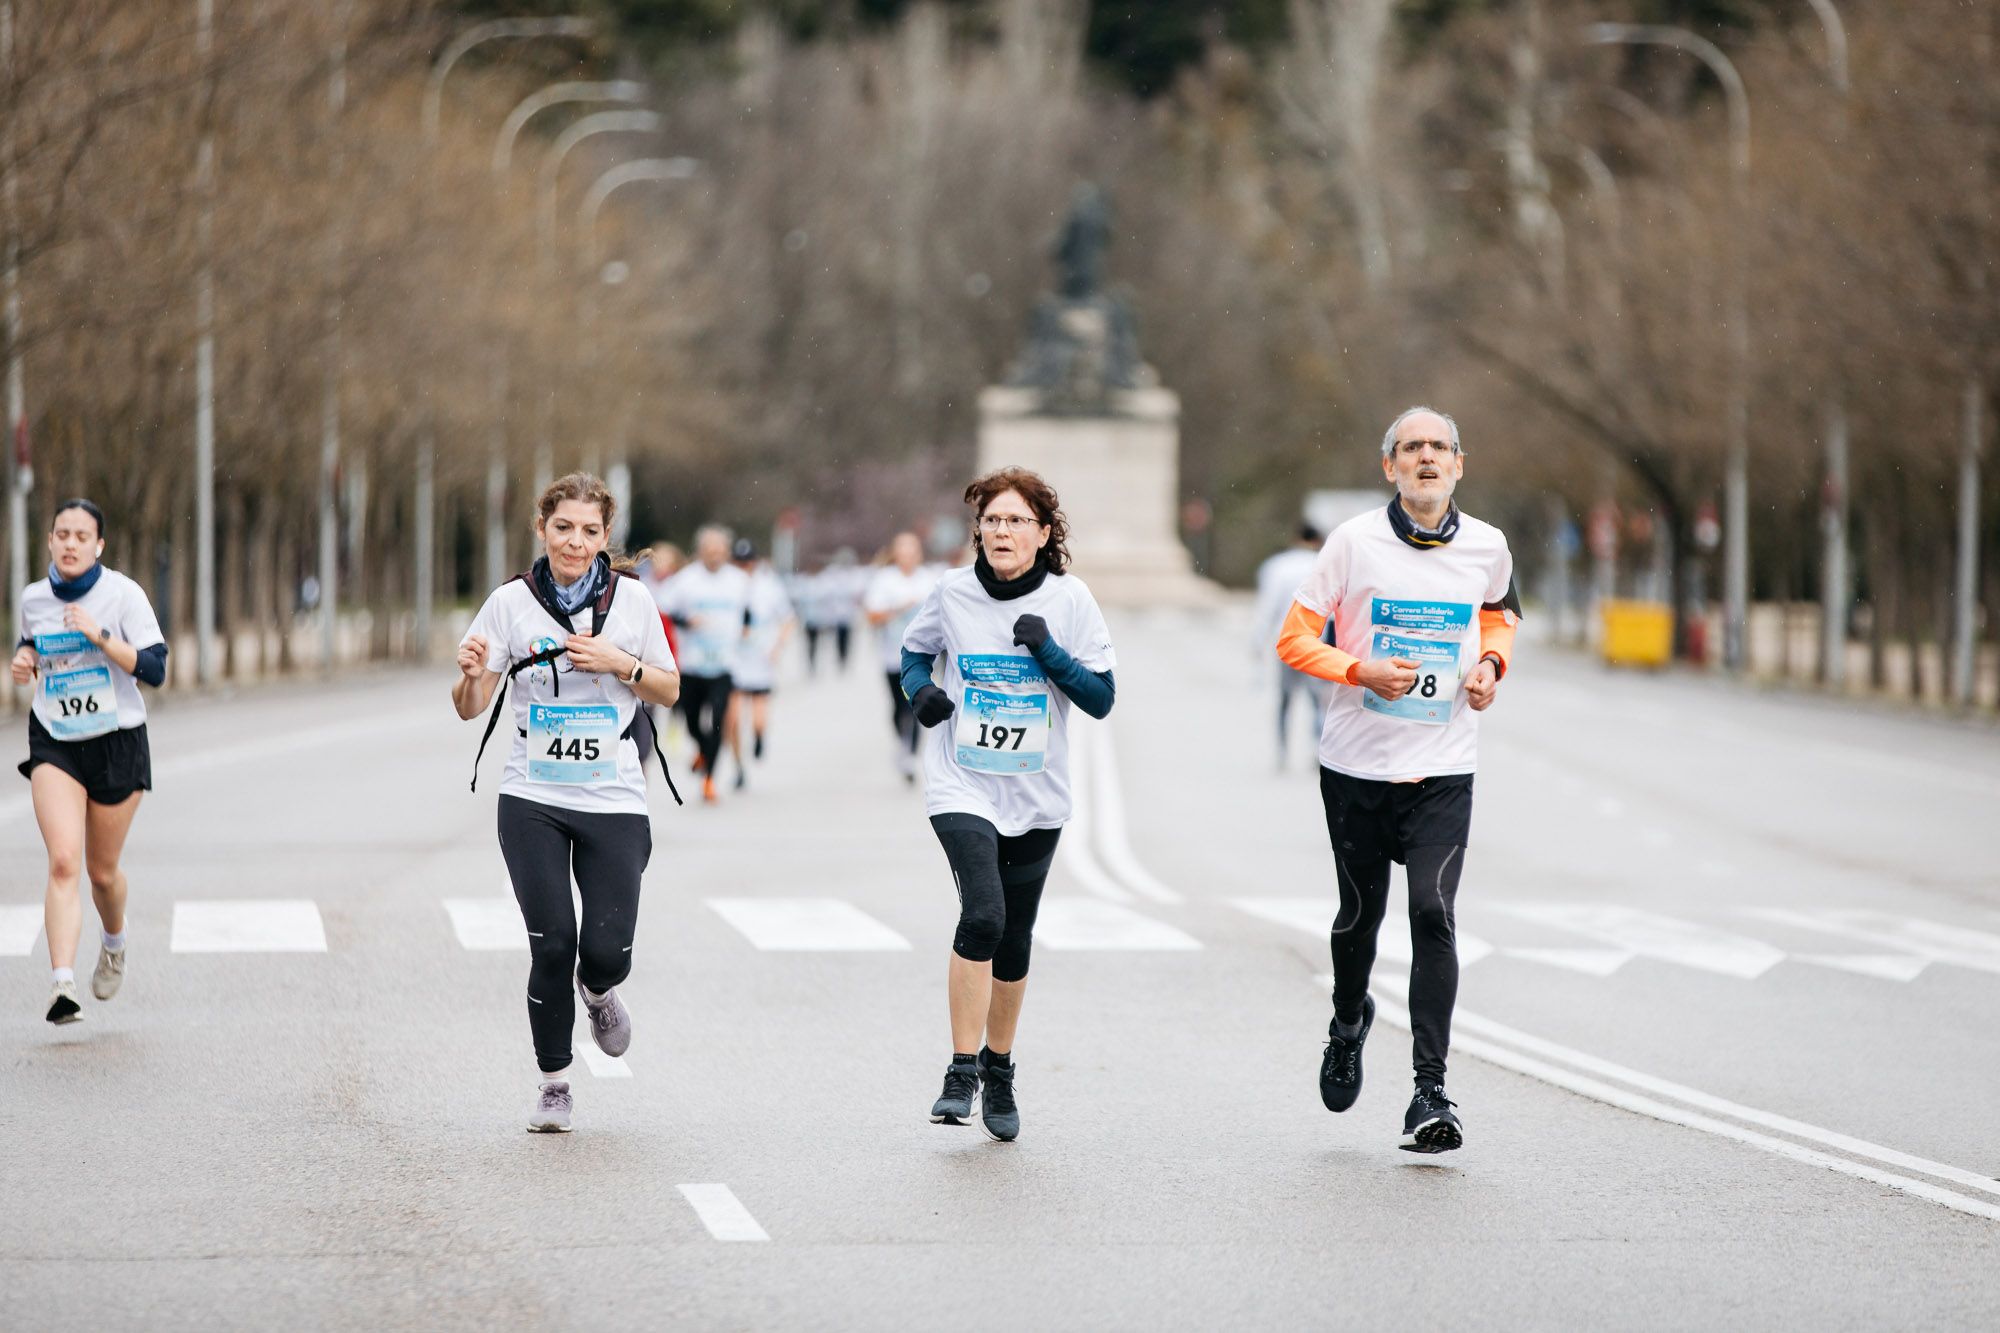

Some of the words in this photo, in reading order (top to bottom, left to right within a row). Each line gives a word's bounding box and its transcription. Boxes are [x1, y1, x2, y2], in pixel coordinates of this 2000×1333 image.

[1392, 606, 1421, 614] Carrera
[1422, 606, 1455, 616] Solidaria
[1392, 640, 1420, 653] Carrera
[1421, 646, 1449, 655] Solidaria
[997, 661, 1029, 669] Solidaria
[1020, 676, 1045, 685] 2026
[59, 694, 99, 716] 196
[981, 694, 1005, 705] Carrera
[1005, 700, 1034, 708] Solidaria
[546, 711, 574, 719] Carrera
[575, 711, 605, 719] Solidaria
[976, 723, 1027, 751] 197
[546, 737, 600, 761] 445
